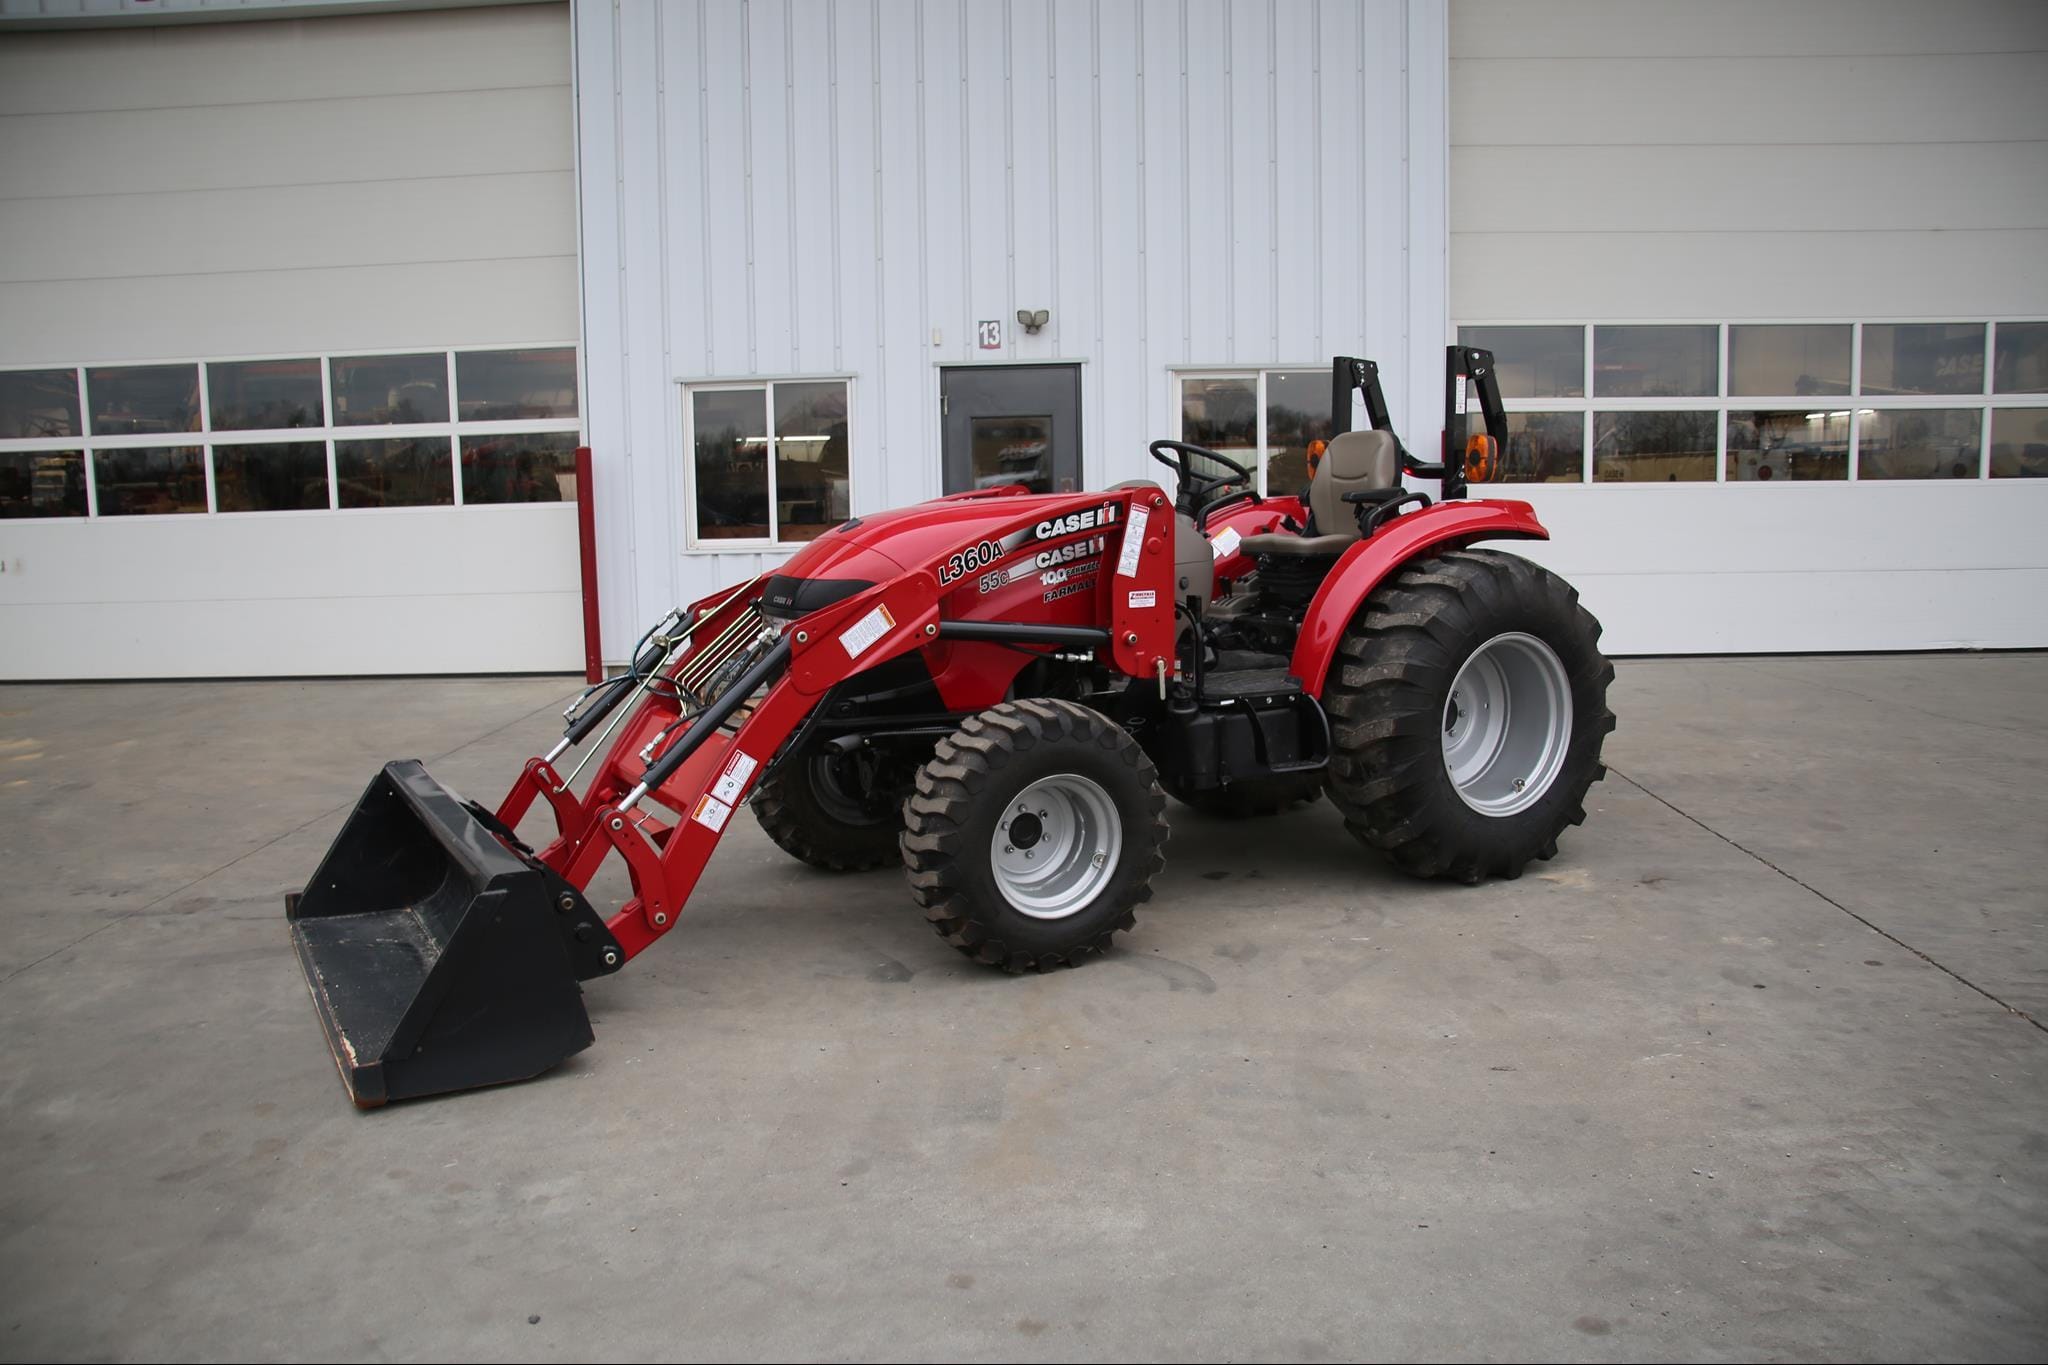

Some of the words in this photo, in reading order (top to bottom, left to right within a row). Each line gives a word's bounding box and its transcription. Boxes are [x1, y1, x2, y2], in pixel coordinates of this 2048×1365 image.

[979, 321, 1000, 346] 13
[1035, 510, 1095, 540] CASE
[938, 540, 1005, 588] L360A
[1035, 541, 1088, 569] CASE
[1043, 579, 1097, 604] FARMALL
